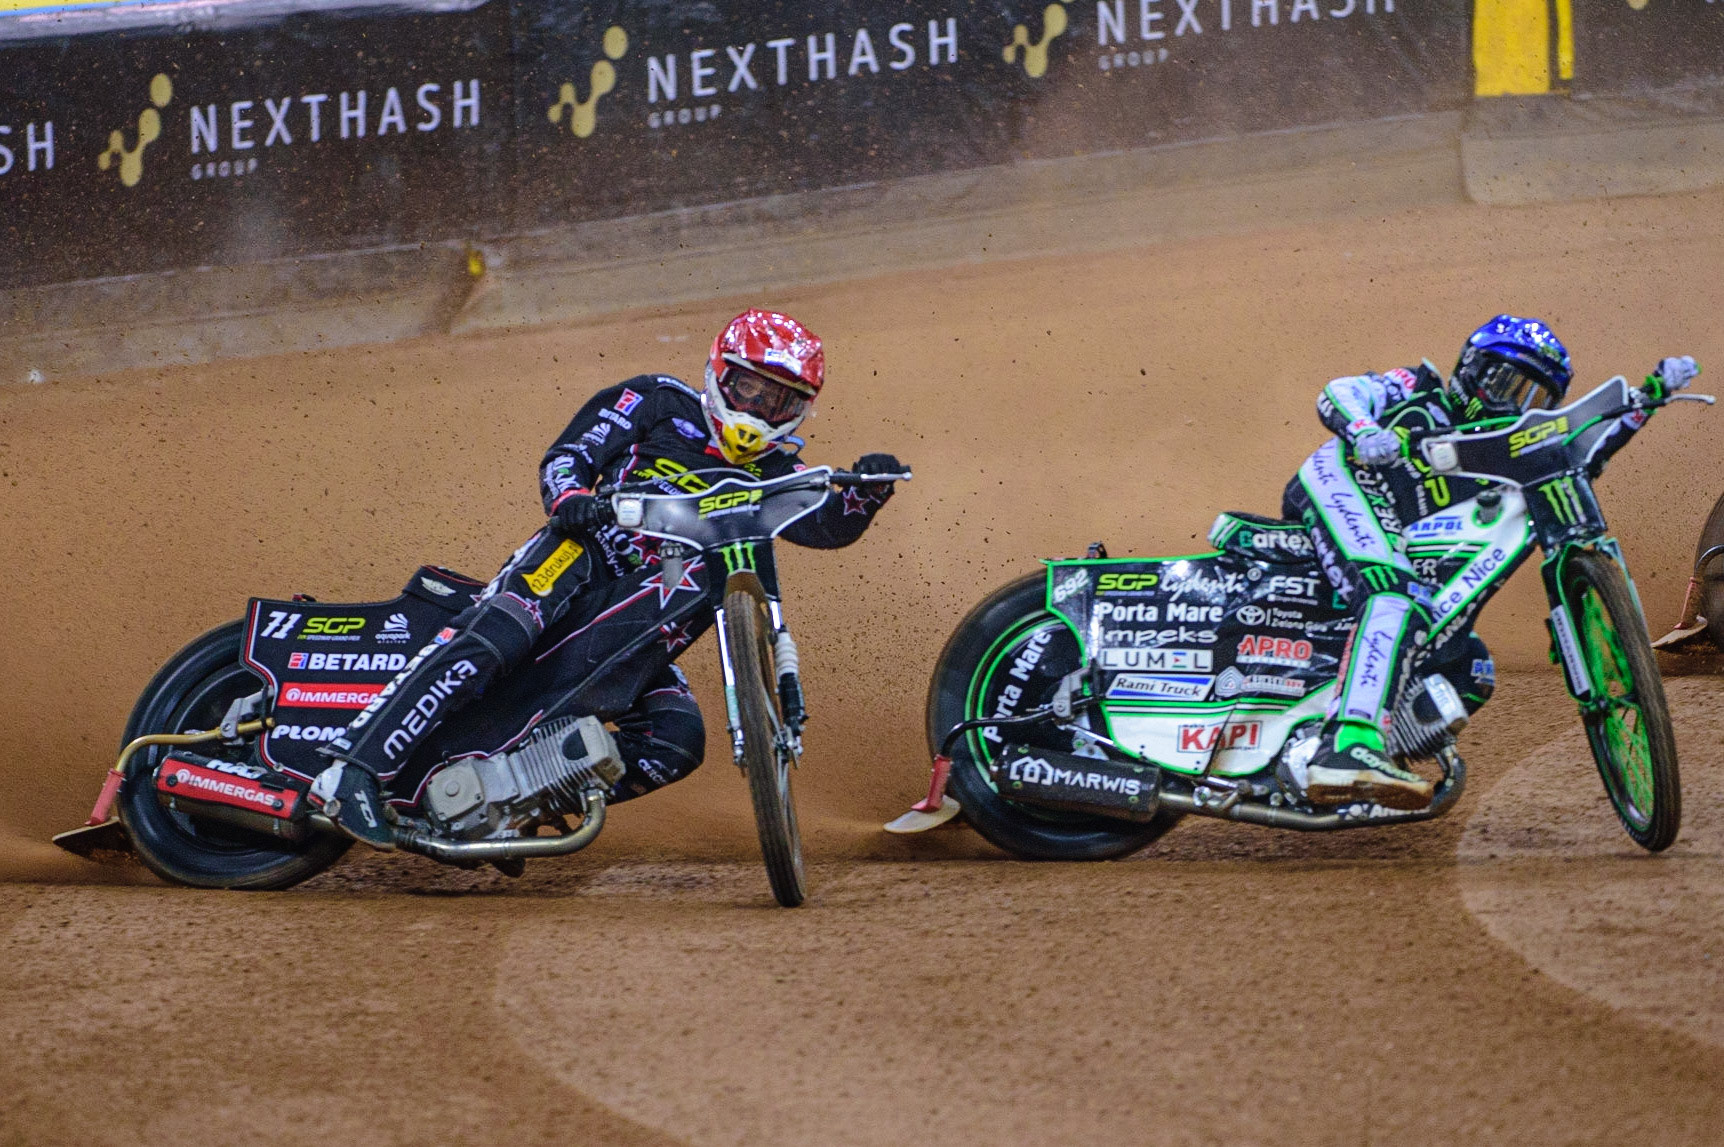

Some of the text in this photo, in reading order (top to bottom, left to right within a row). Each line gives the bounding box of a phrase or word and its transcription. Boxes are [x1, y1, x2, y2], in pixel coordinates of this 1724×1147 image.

[1098, 0, 1395, 46] NEXTH
[647, 17, 958, 102] NEXTHASH
[190, 78, 482, 154] NEXTHASH
[648, 104, 722, 129] GROUP
[190, 157, 258, 180] GROUP
[1508, 420, 1557, 451] SGP
[652, 475, 685, 496] SPEEDW
[699, 489, 751, 514] SGP
[1409, 520, 1464, 532] ARPOL
[1462, 546, 1508, 590] Nice
[1053, 568, 1090, 602] 692
[1097, 574, 1159, 590] SGP
[260, 610, 302, 640] 71
[1099, 601, 1224, 622] Porta Mare
[303, 617, 366, 634] SGP
[1009, 631, 1052, 681] Mare
[1237, 634, 1313, 661] APRO
[308, 653, 407, 671] BETARD
[300, 689, 380, 705] IMMERGA
[1116, 677, 1202, 697] Rami Truck
[1181, 723, 1258, 750] KAPI
[188, 774, 277, 805] IMMERGAS
[1054, 768, 1141, 796] MARWIS
